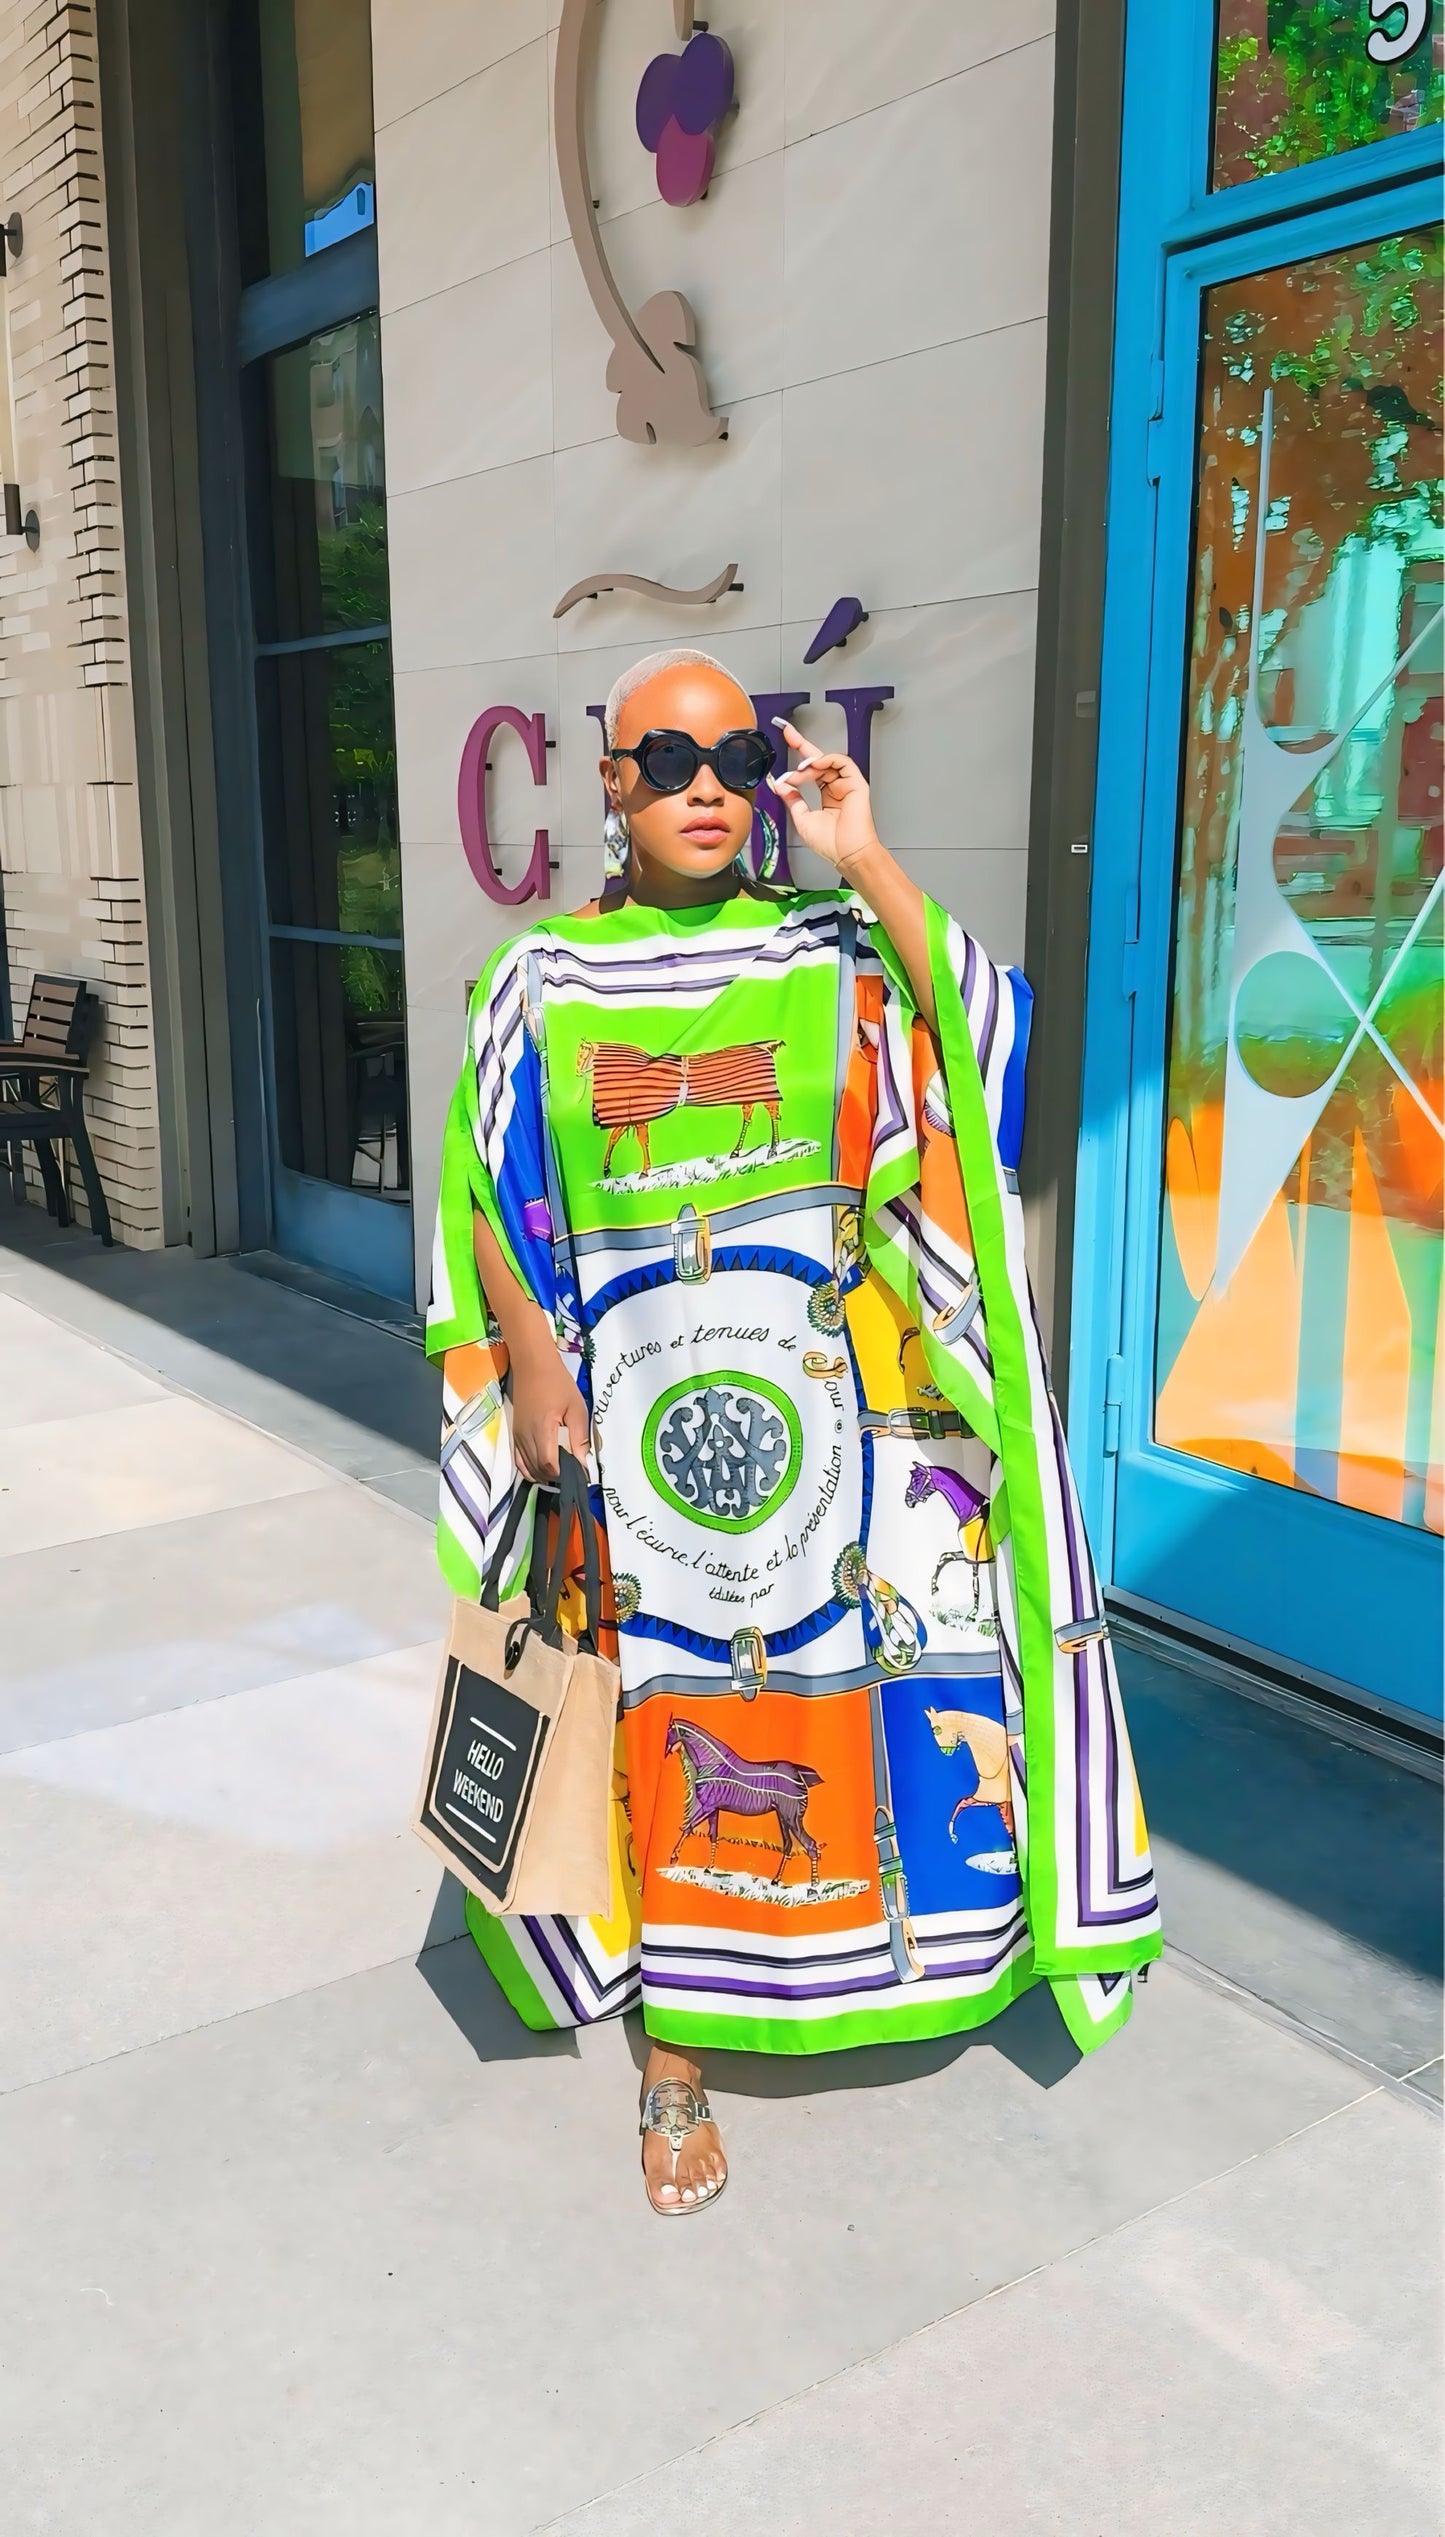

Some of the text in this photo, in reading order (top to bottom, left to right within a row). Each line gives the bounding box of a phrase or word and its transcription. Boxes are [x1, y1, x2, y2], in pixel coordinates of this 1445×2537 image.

[670, 1335, 684, 1349] et
[691, 1324, 770, 1344] tenues
[778, 1335, 797, 1352] de
[766, 1550, 783, 1572] et
[750, 1583, 775, 1608] par
[467, 1739, 505, 1781] HELLO
[453, 1768, 505, 1823] WEEKEND
